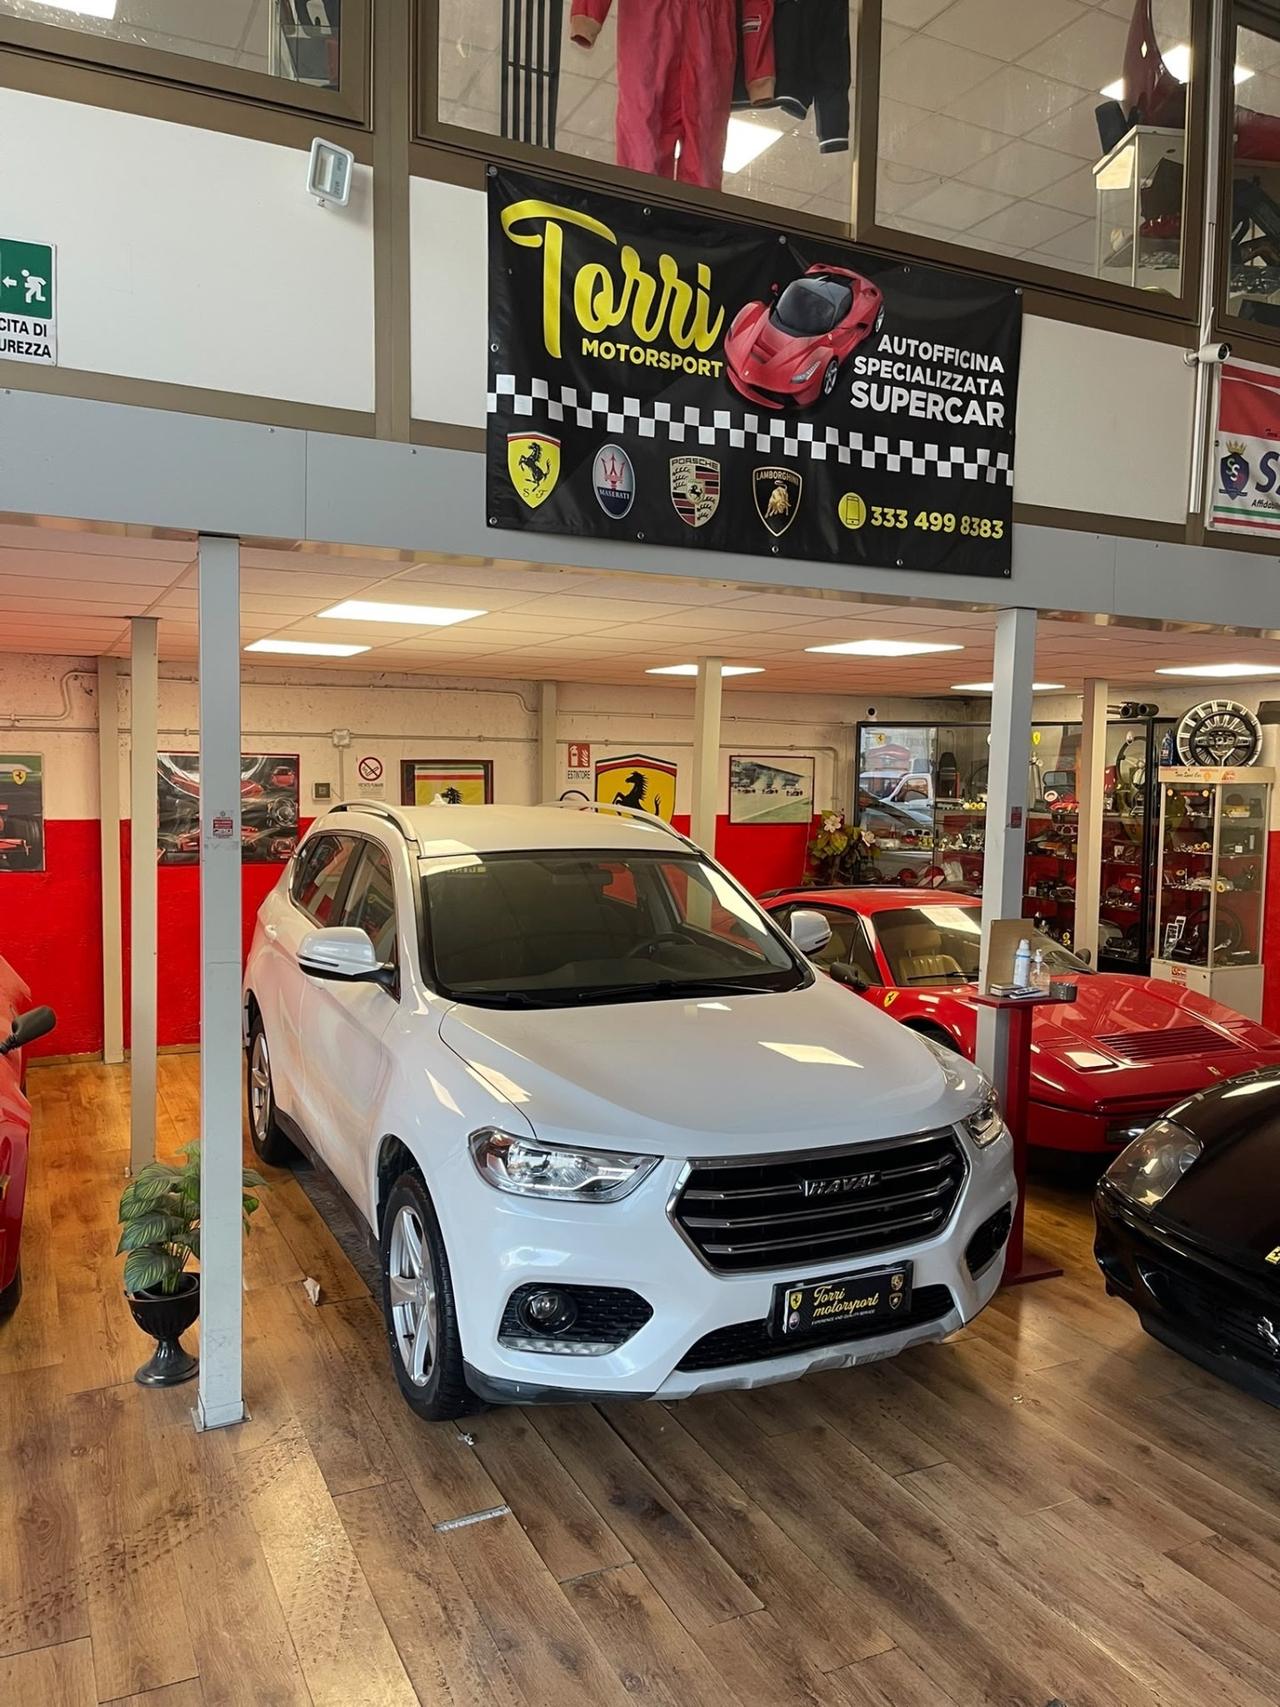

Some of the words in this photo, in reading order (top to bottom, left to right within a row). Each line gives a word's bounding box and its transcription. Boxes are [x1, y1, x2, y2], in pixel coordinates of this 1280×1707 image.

[500, 199, 725, 359] Torri
[0, 317, 30, 335] CITA
[33, 322, 47, 337] DI
[581, 338, 724, 378] MOTORSPORT
[877, 334, 1005, 374] AUTOFFICINA
[853, 355, 1005, 396] SPECIALIZZATA
[850, 380, 1005, 428] SUPERCAR
[671, 457, 719, 470] PORSCHE
[599, 488, 630, 500] MASERATI
[870, 505, 908, 529] 333
[914, 511, 956, 533] 499
[960, 515, 1004, 539] 8383
[812, 1292, 879, 1317] motorsport
[813, 1285, 846, 1306] Torri
